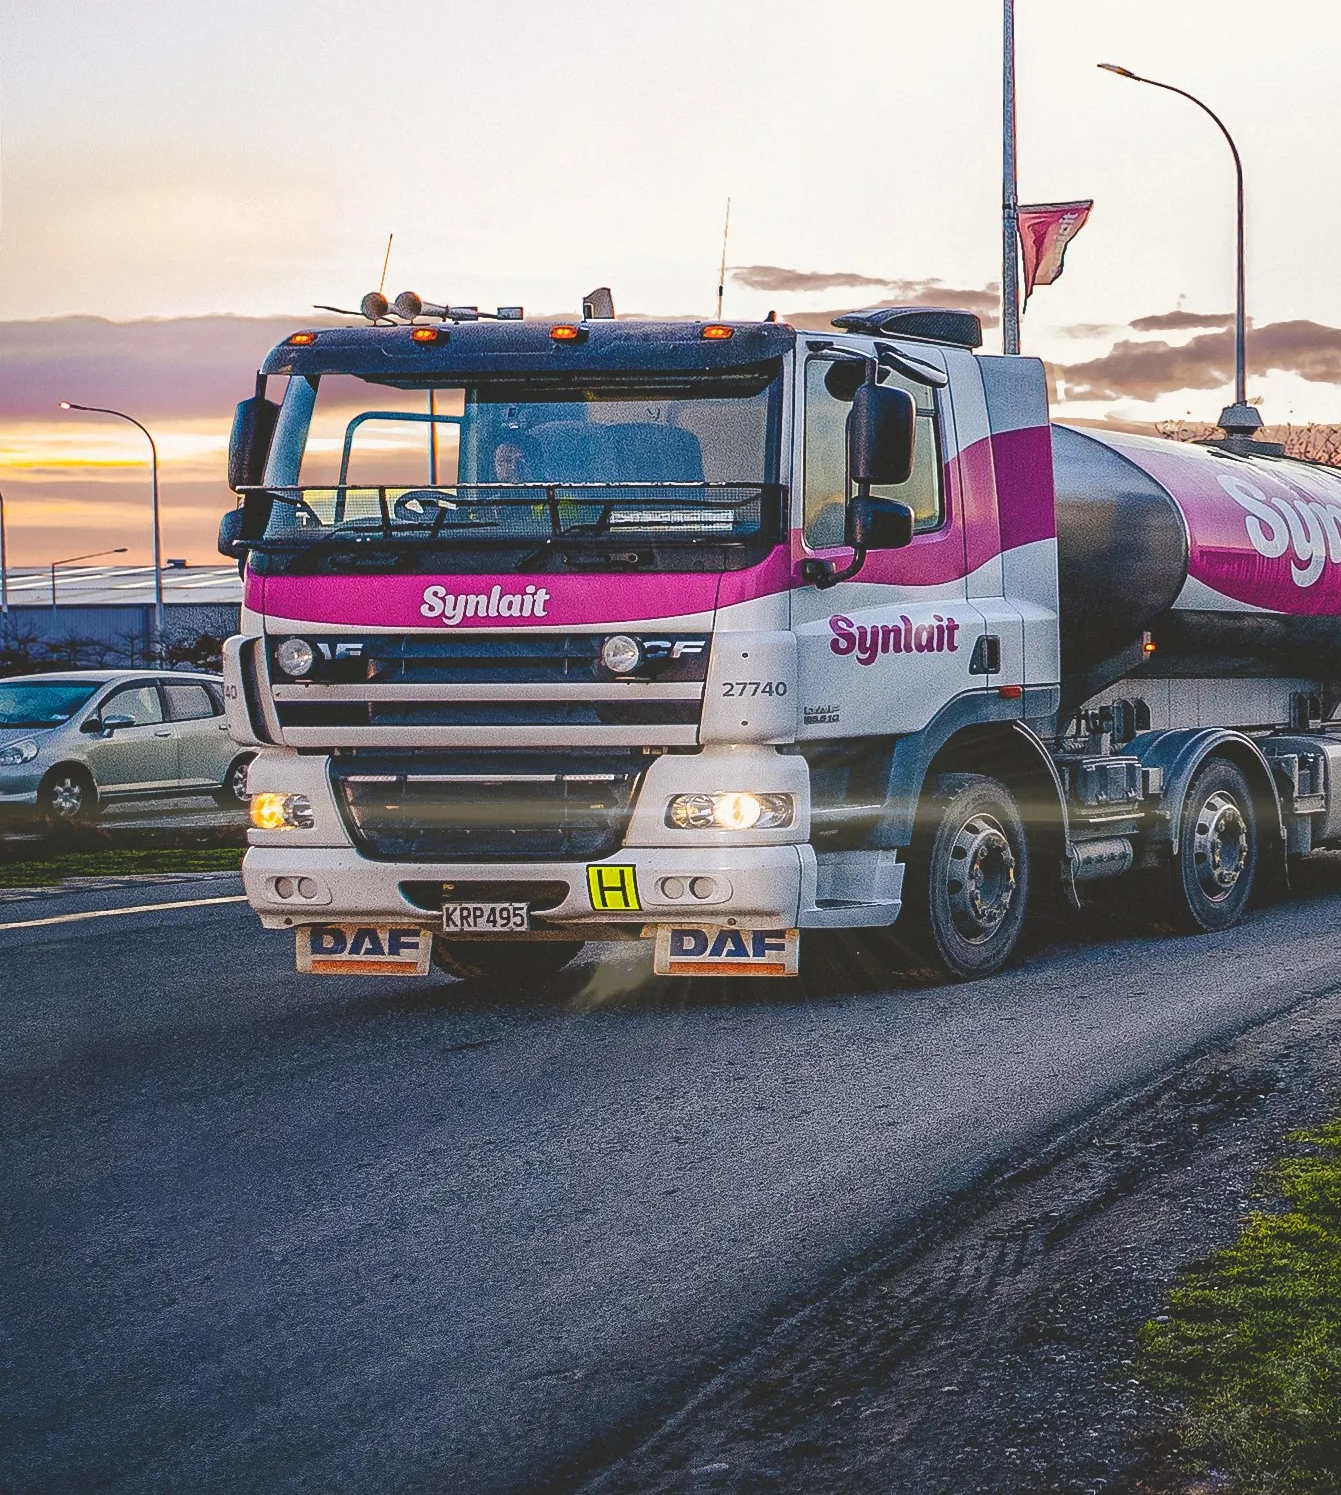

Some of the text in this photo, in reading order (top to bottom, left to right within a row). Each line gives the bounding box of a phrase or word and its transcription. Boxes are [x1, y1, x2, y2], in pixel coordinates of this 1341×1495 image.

[420, 585, 550, 625] Synlait
[828, 614, 960, 666] Synlait
[721, 681, 788, 697] 27740
[597, 869, 631, 908] H
[445, 906, 525, 928] KRP495
[309, 927, 420, 956] DAF
[669, 929, 786, 957] DAF
